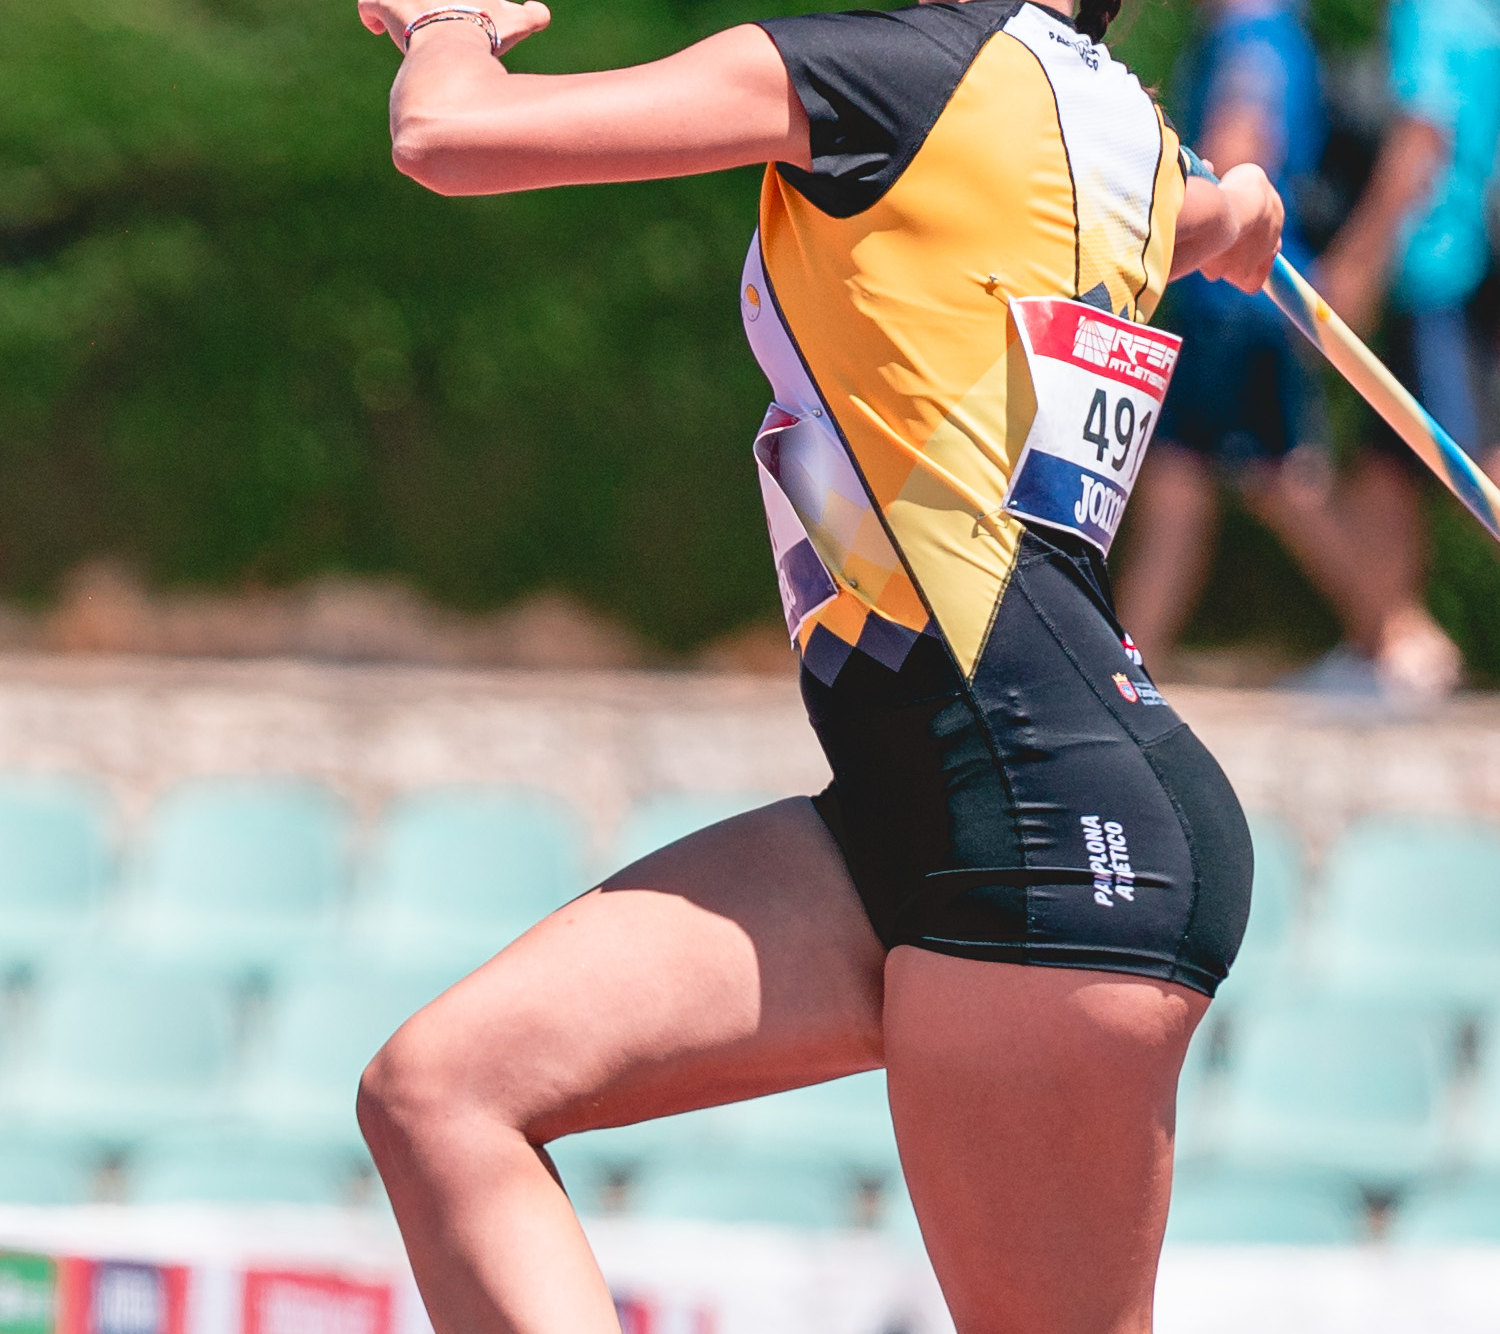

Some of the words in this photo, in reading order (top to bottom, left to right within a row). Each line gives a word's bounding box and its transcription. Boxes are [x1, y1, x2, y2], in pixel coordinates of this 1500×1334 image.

[1111, 328, 1178, 373] RFEA
[1082, 387, 1153, 482] 491
[1074, 473, 1126, 535] Jom
